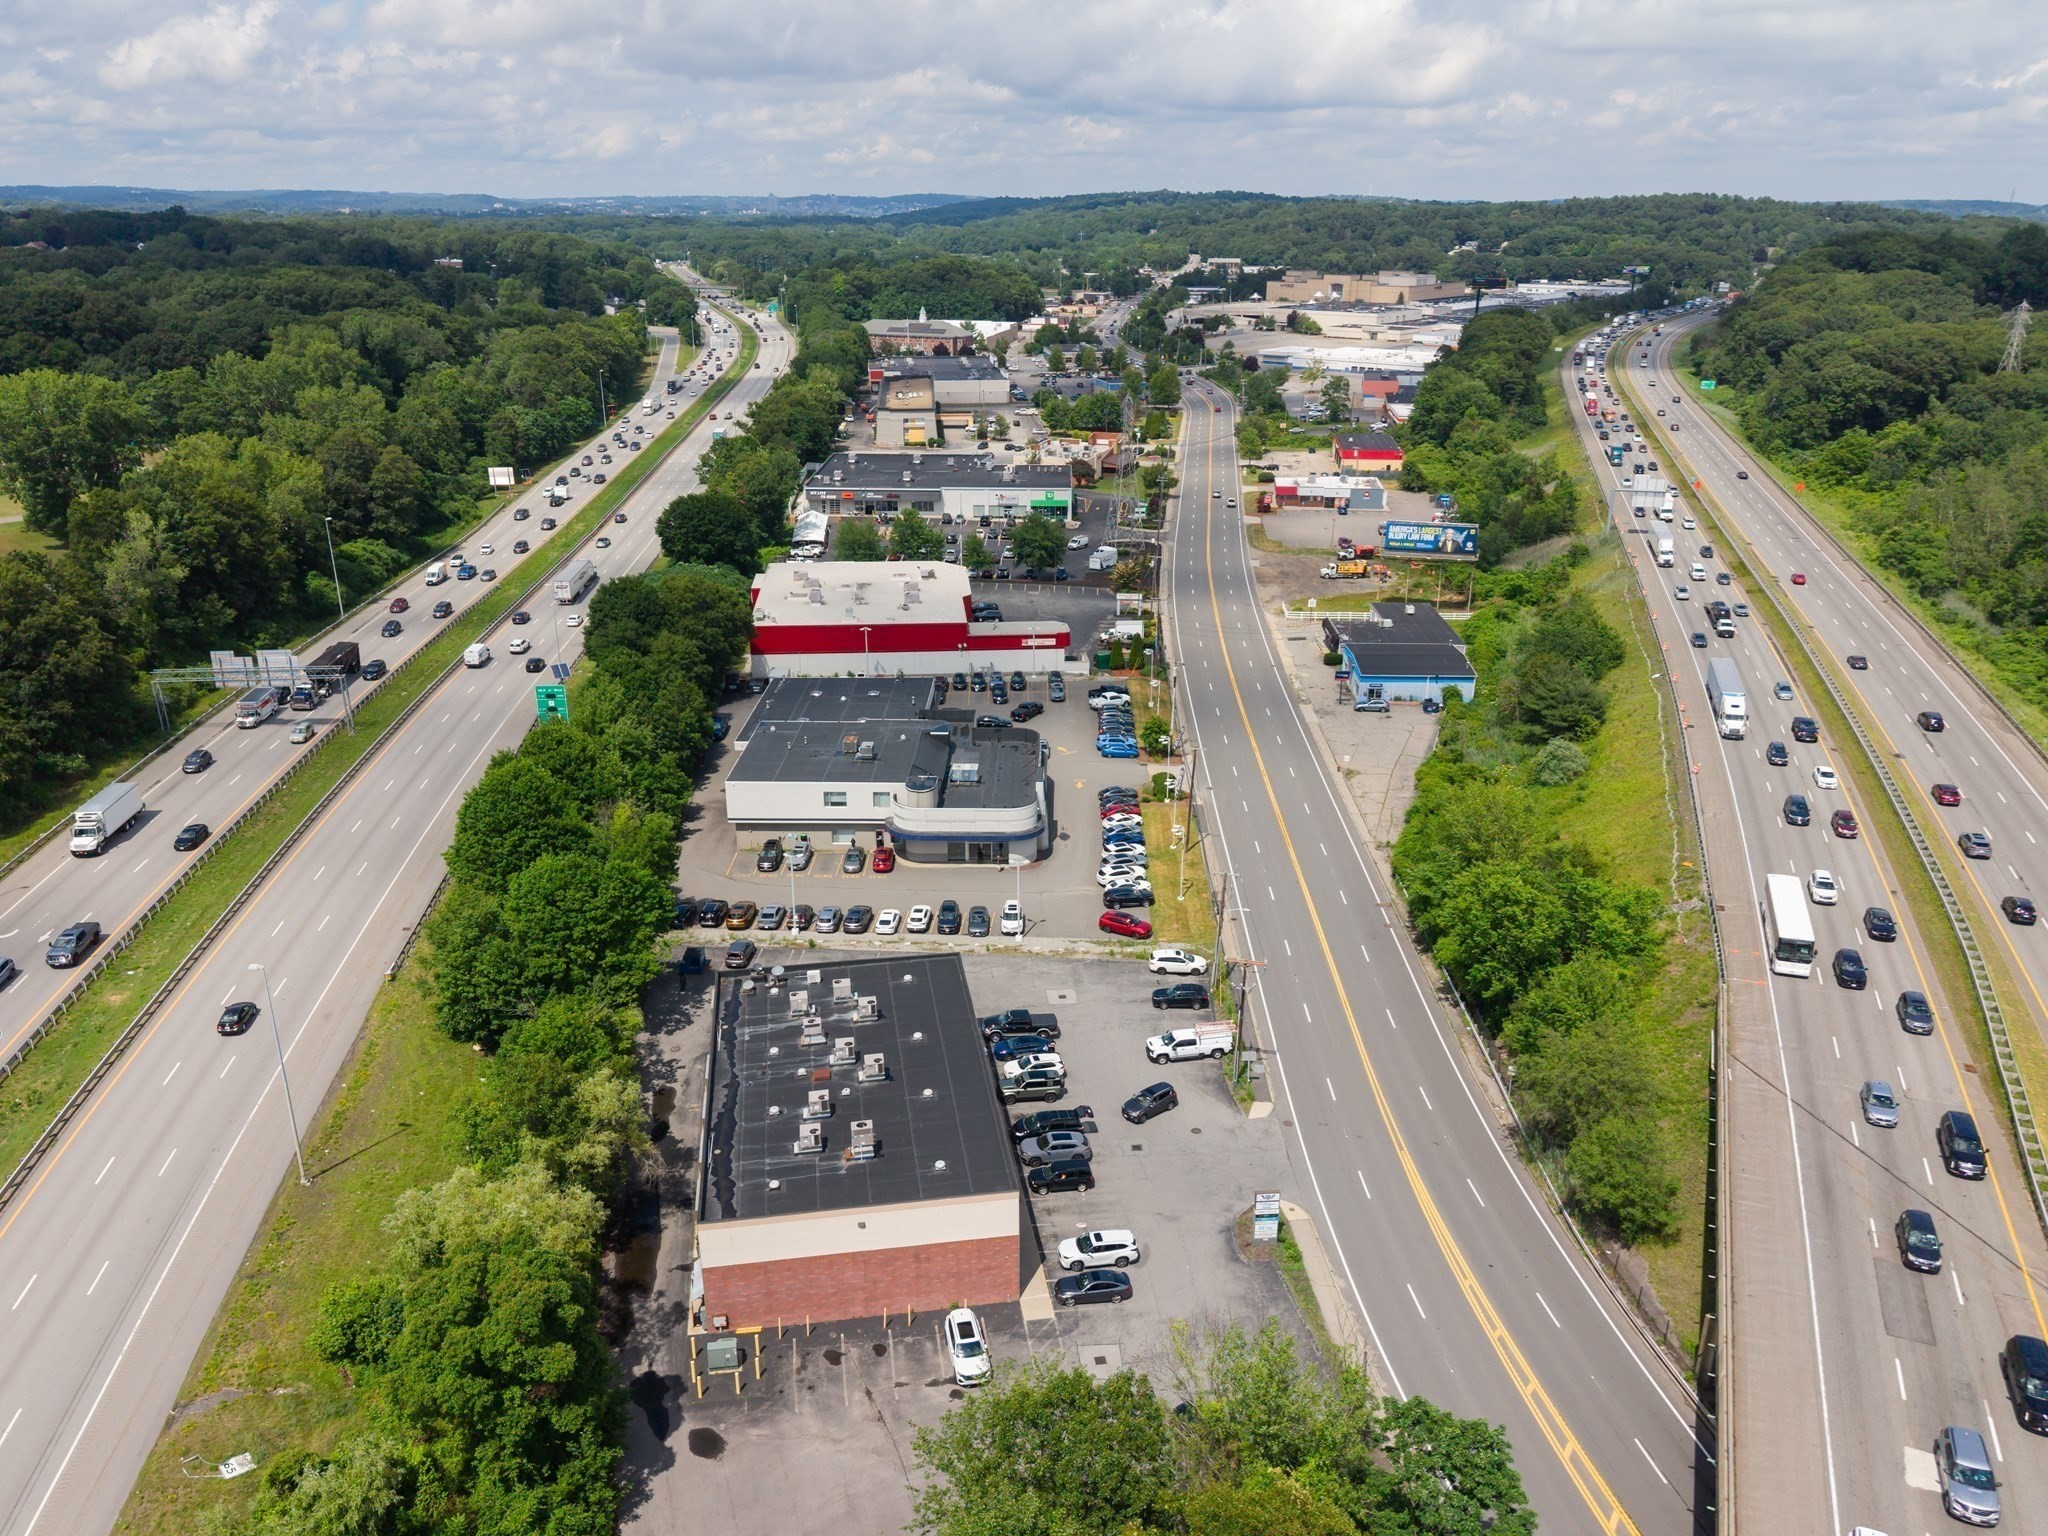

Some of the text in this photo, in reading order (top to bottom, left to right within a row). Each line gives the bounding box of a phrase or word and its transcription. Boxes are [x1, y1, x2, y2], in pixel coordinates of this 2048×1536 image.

[1389, 525, 1442, 535] AMERICA'S LARGEST
[1388, 532, 1407, 540] INJURY
[224, 1462, 236, 1474] 65
